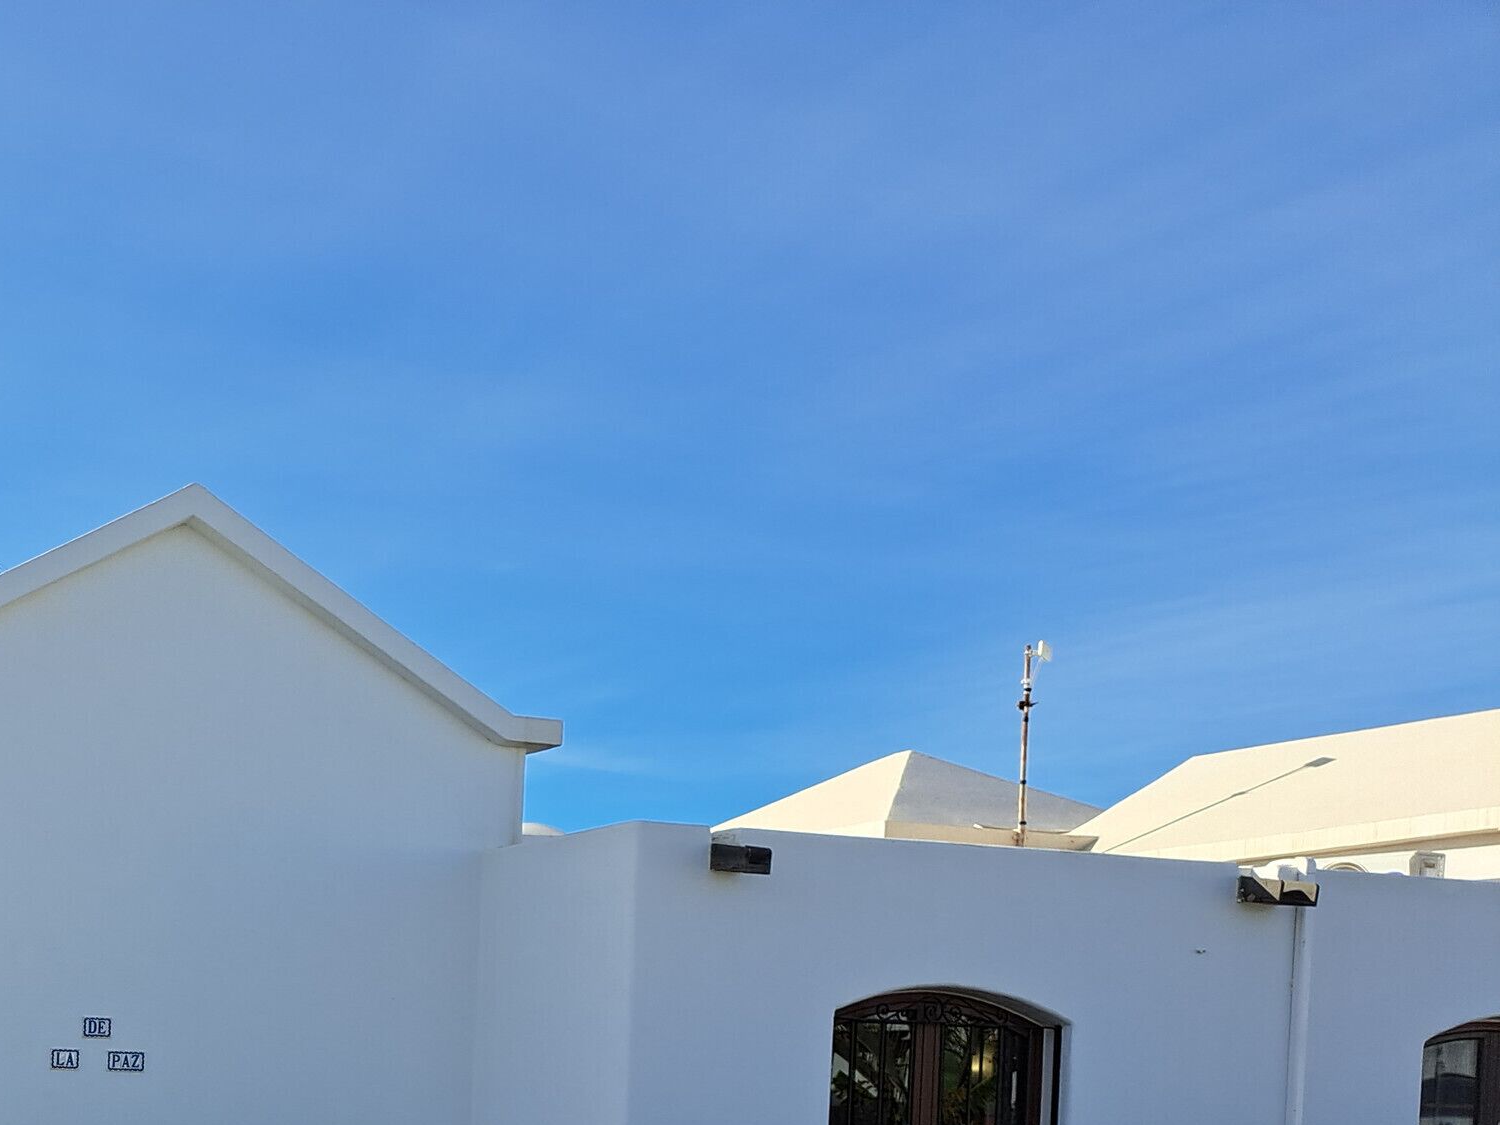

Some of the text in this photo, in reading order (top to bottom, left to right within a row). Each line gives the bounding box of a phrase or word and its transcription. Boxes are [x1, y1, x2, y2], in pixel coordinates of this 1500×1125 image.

[88, 1020, 106, 1034] DE
[56, 1052, 140, 1068] LA PAZ
